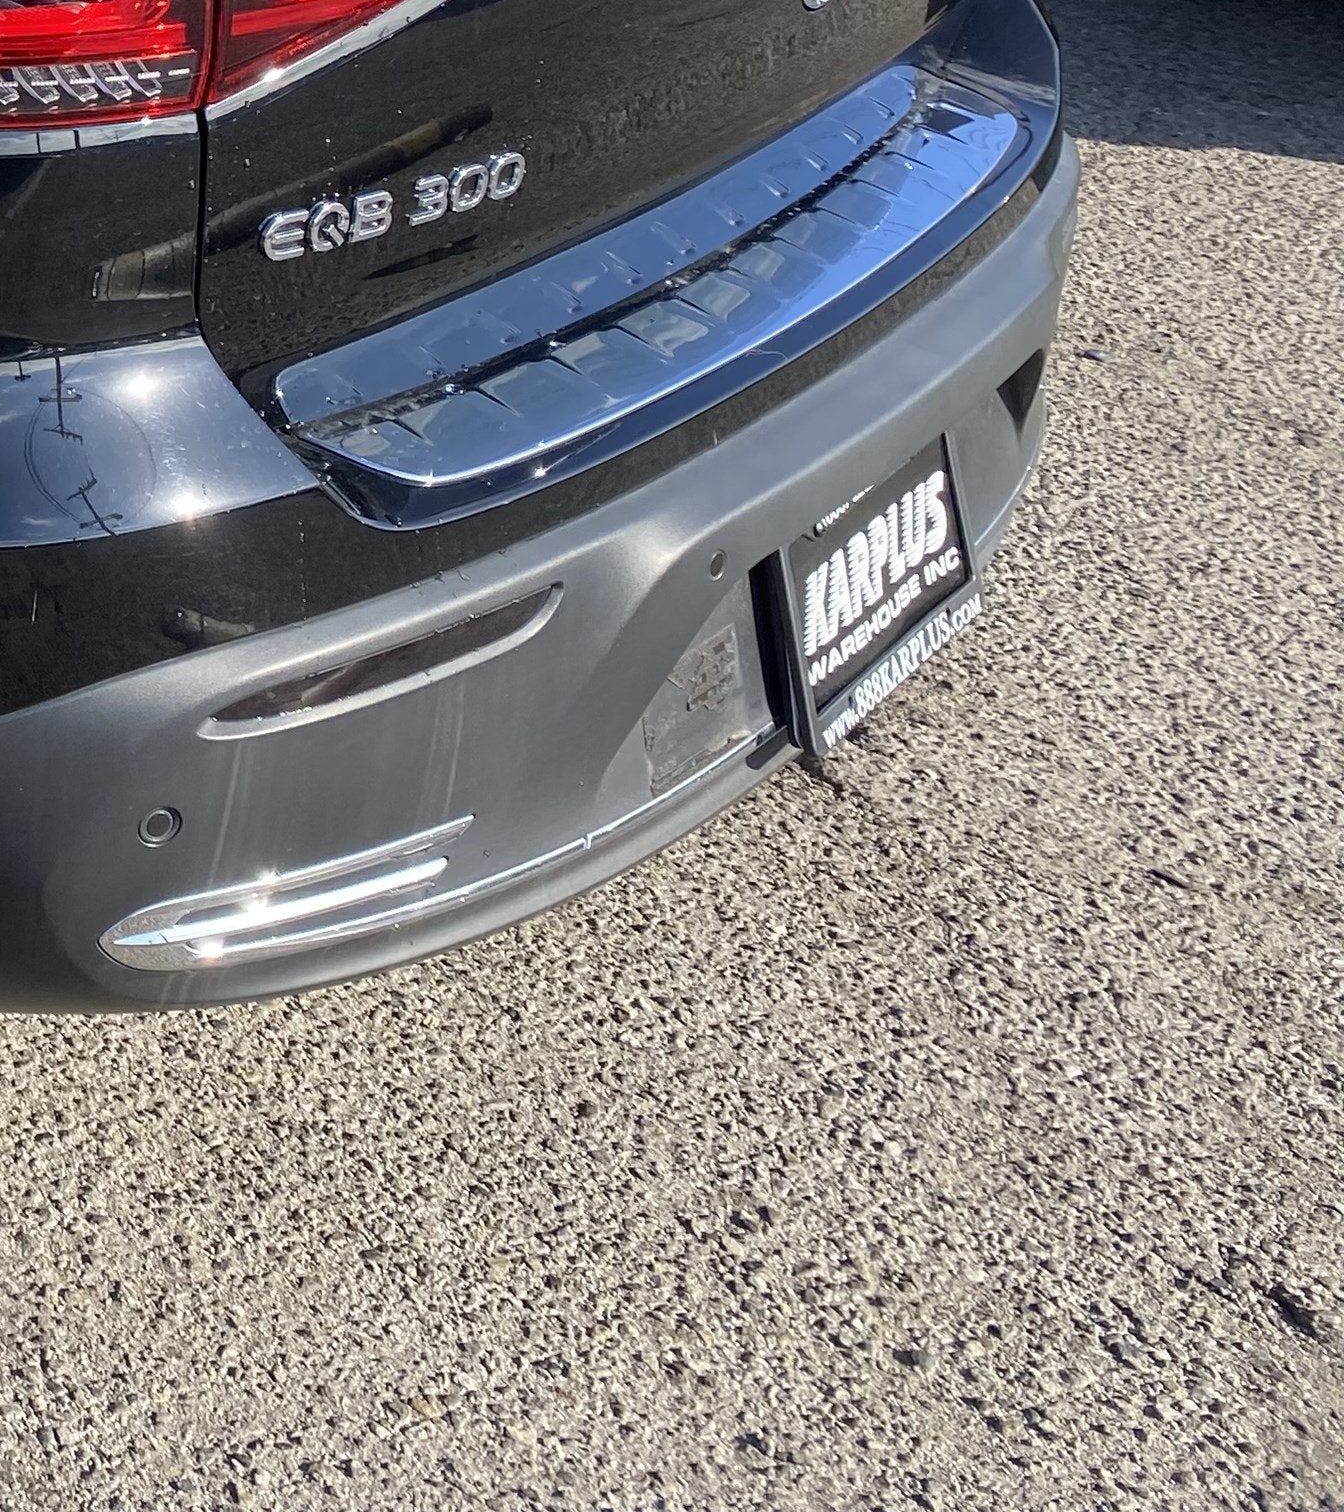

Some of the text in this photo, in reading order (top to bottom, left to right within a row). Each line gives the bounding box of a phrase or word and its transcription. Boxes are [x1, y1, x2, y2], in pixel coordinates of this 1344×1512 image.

[259, 151, 526, 261] EQB 300
[804, 470, 948, 657] KARPLUS
[808, 546, 961, 687] WAREHOUSE INC
